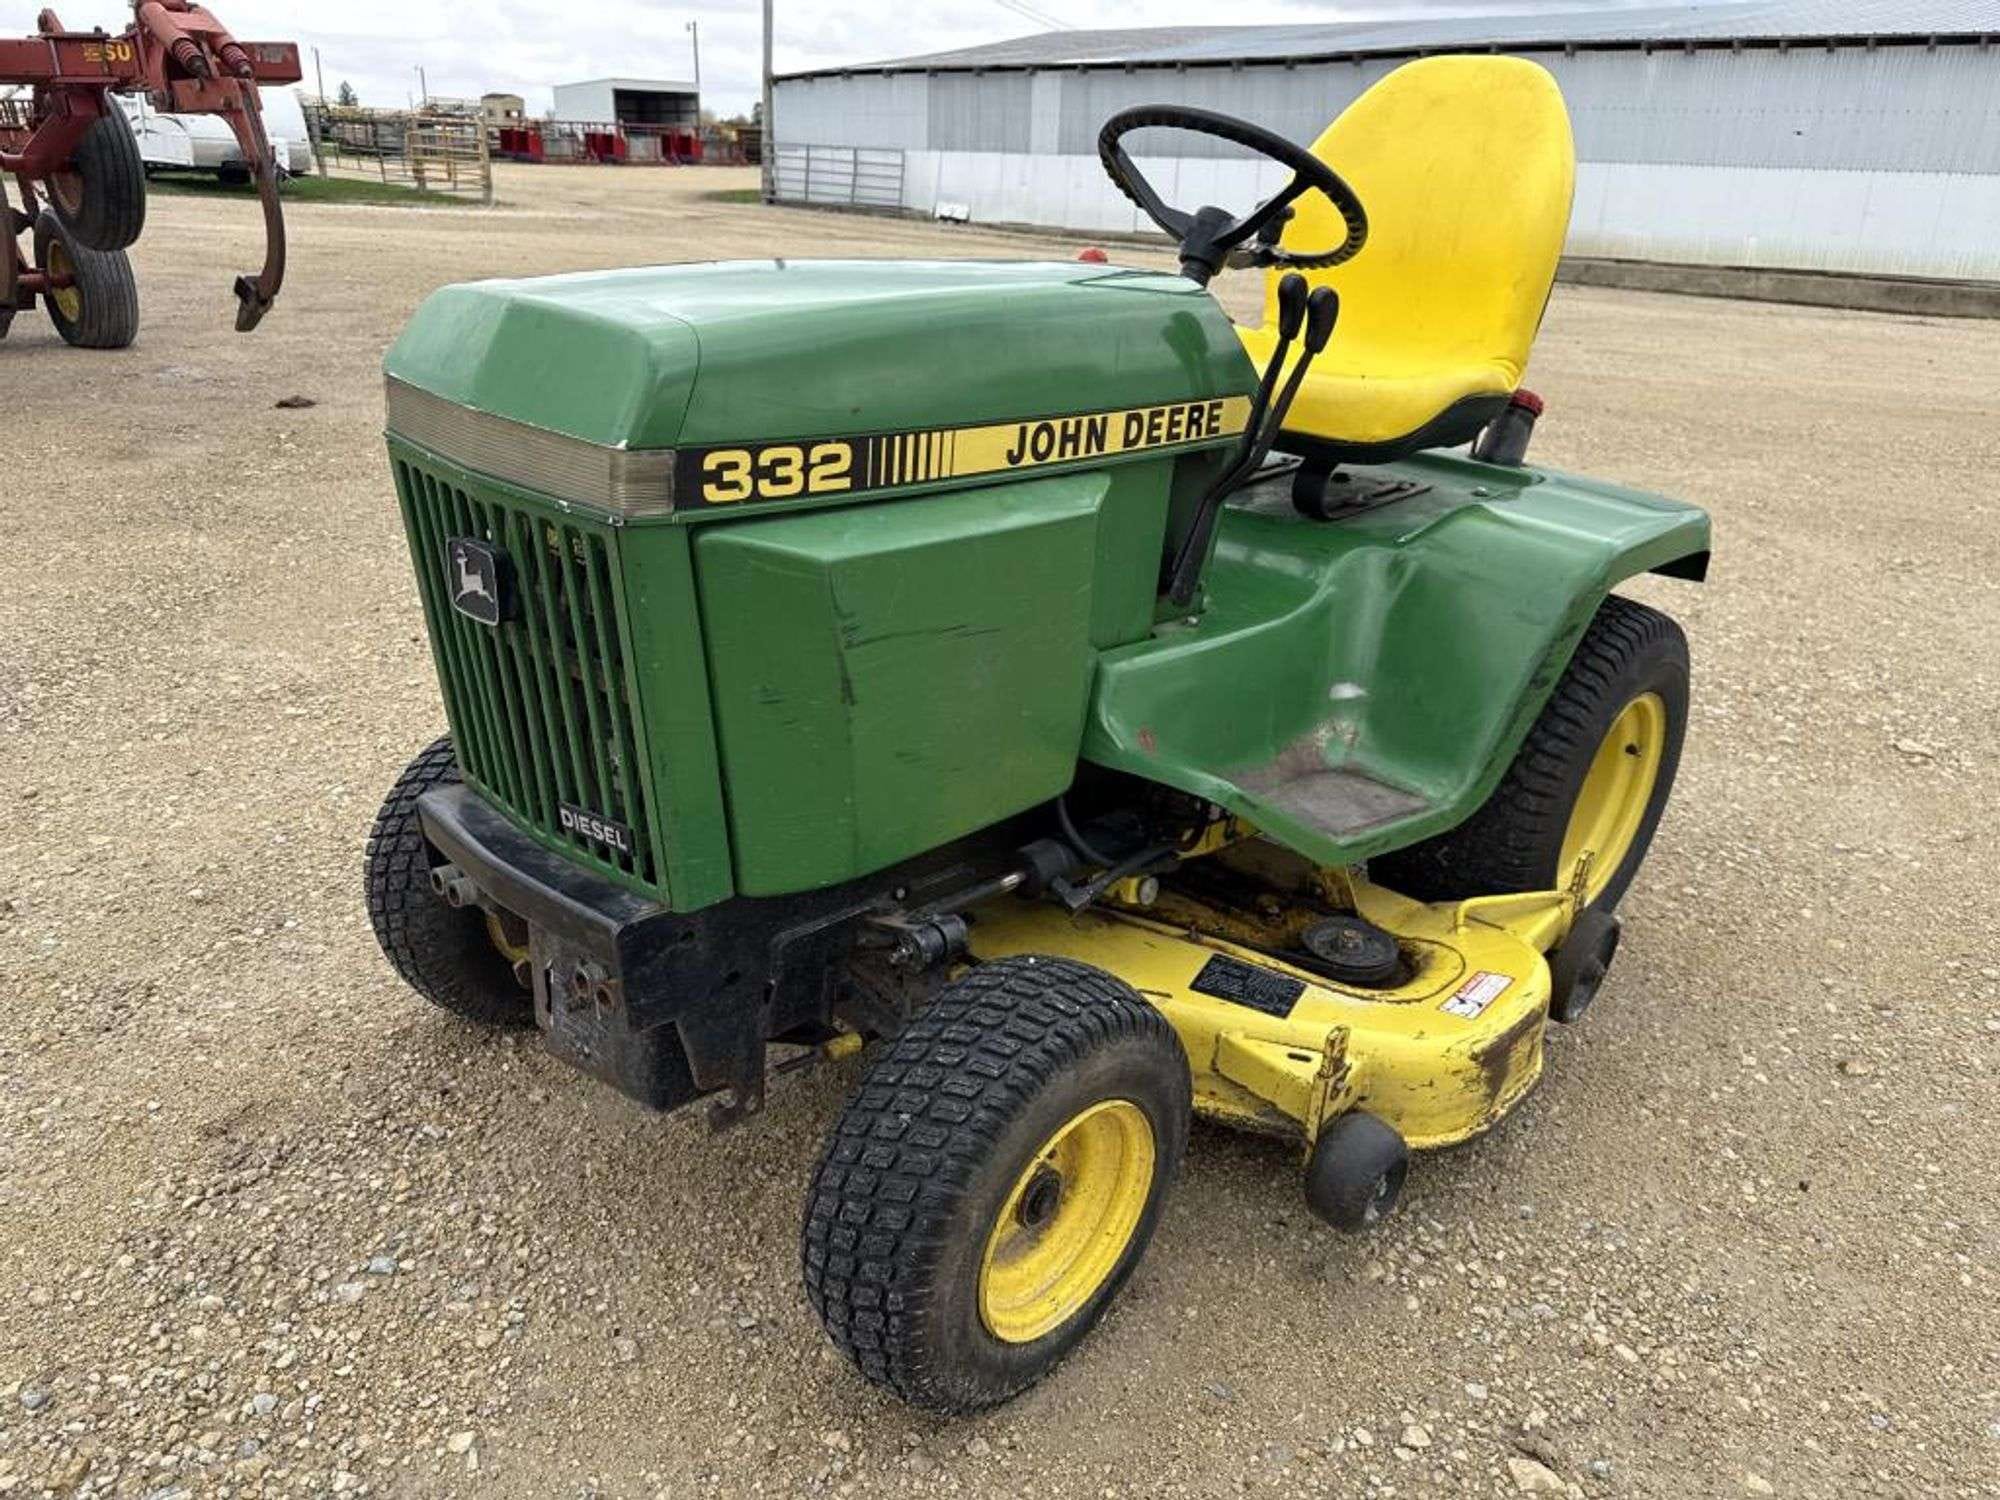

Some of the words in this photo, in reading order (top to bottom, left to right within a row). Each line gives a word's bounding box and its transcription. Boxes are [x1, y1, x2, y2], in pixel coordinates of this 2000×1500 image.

[703, 443, 852, 502] 332
[1006, 416, 1108, 466] JOHN
[1123, 401, 1223, 448] DEERE
[560, 808, 628, 851] DIESEL
